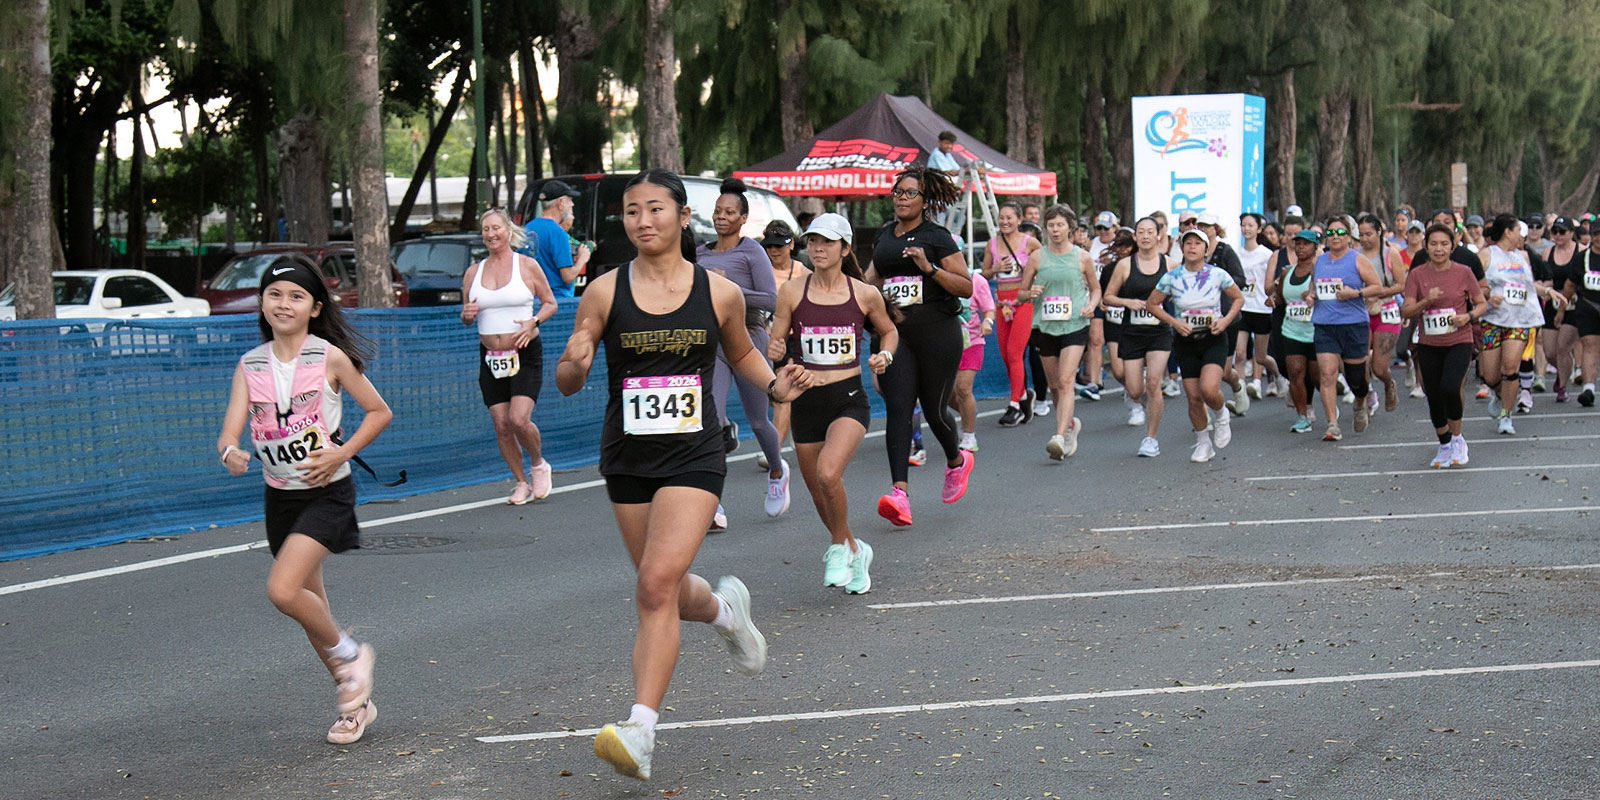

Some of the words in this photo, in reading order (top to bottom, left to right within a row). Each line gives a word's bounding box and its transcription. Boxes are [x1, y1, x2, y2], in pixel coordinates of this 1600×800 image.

[808, 138, 919, 162] ESPN
[800, 154, 911, 168] HONOLULU
[887, 284, 918, 298] 1293
[1043, 303, 1069, 314] 1355
[1289, 307, 1311, 317] 1286
[1184, 316, 1212, 325] 1488
[620, 329, 707, 348] MILILANI
[805, 338, 851, 354] 1155
[488, 357, 514, 371] 1551
[626, 378, 642, 388] 5K
[667, 376, 698, 387] 2026
[629, 393, 695, 419] 1343
[286, 416, 312, 434] 2026
[261, 431, 323, 466] 1462
